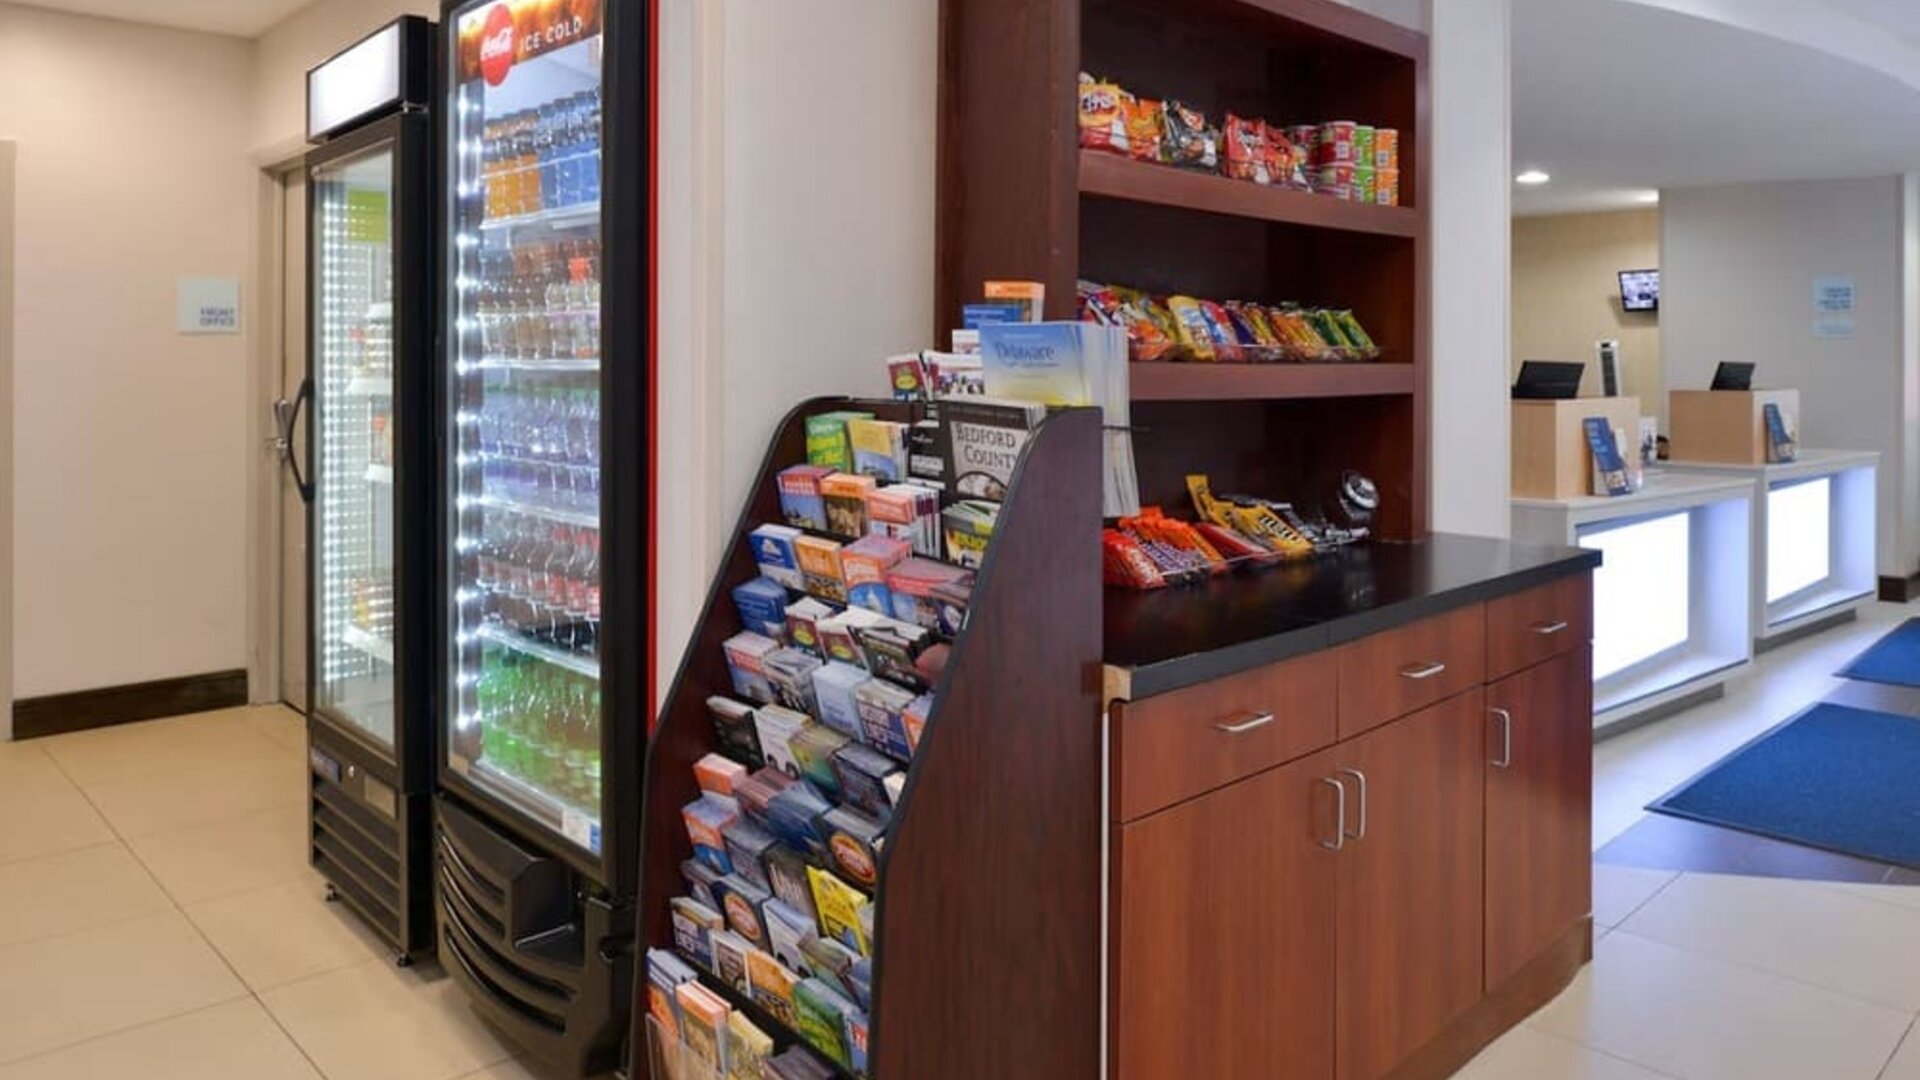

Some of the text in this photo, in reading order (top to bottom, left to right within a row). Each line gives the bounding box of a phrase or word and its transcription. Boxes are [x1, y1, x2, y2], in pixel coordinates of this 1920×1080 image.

[519, 15, 583, 53] ICE COLD
[955, 421, 1017, 449] BEDFORD
